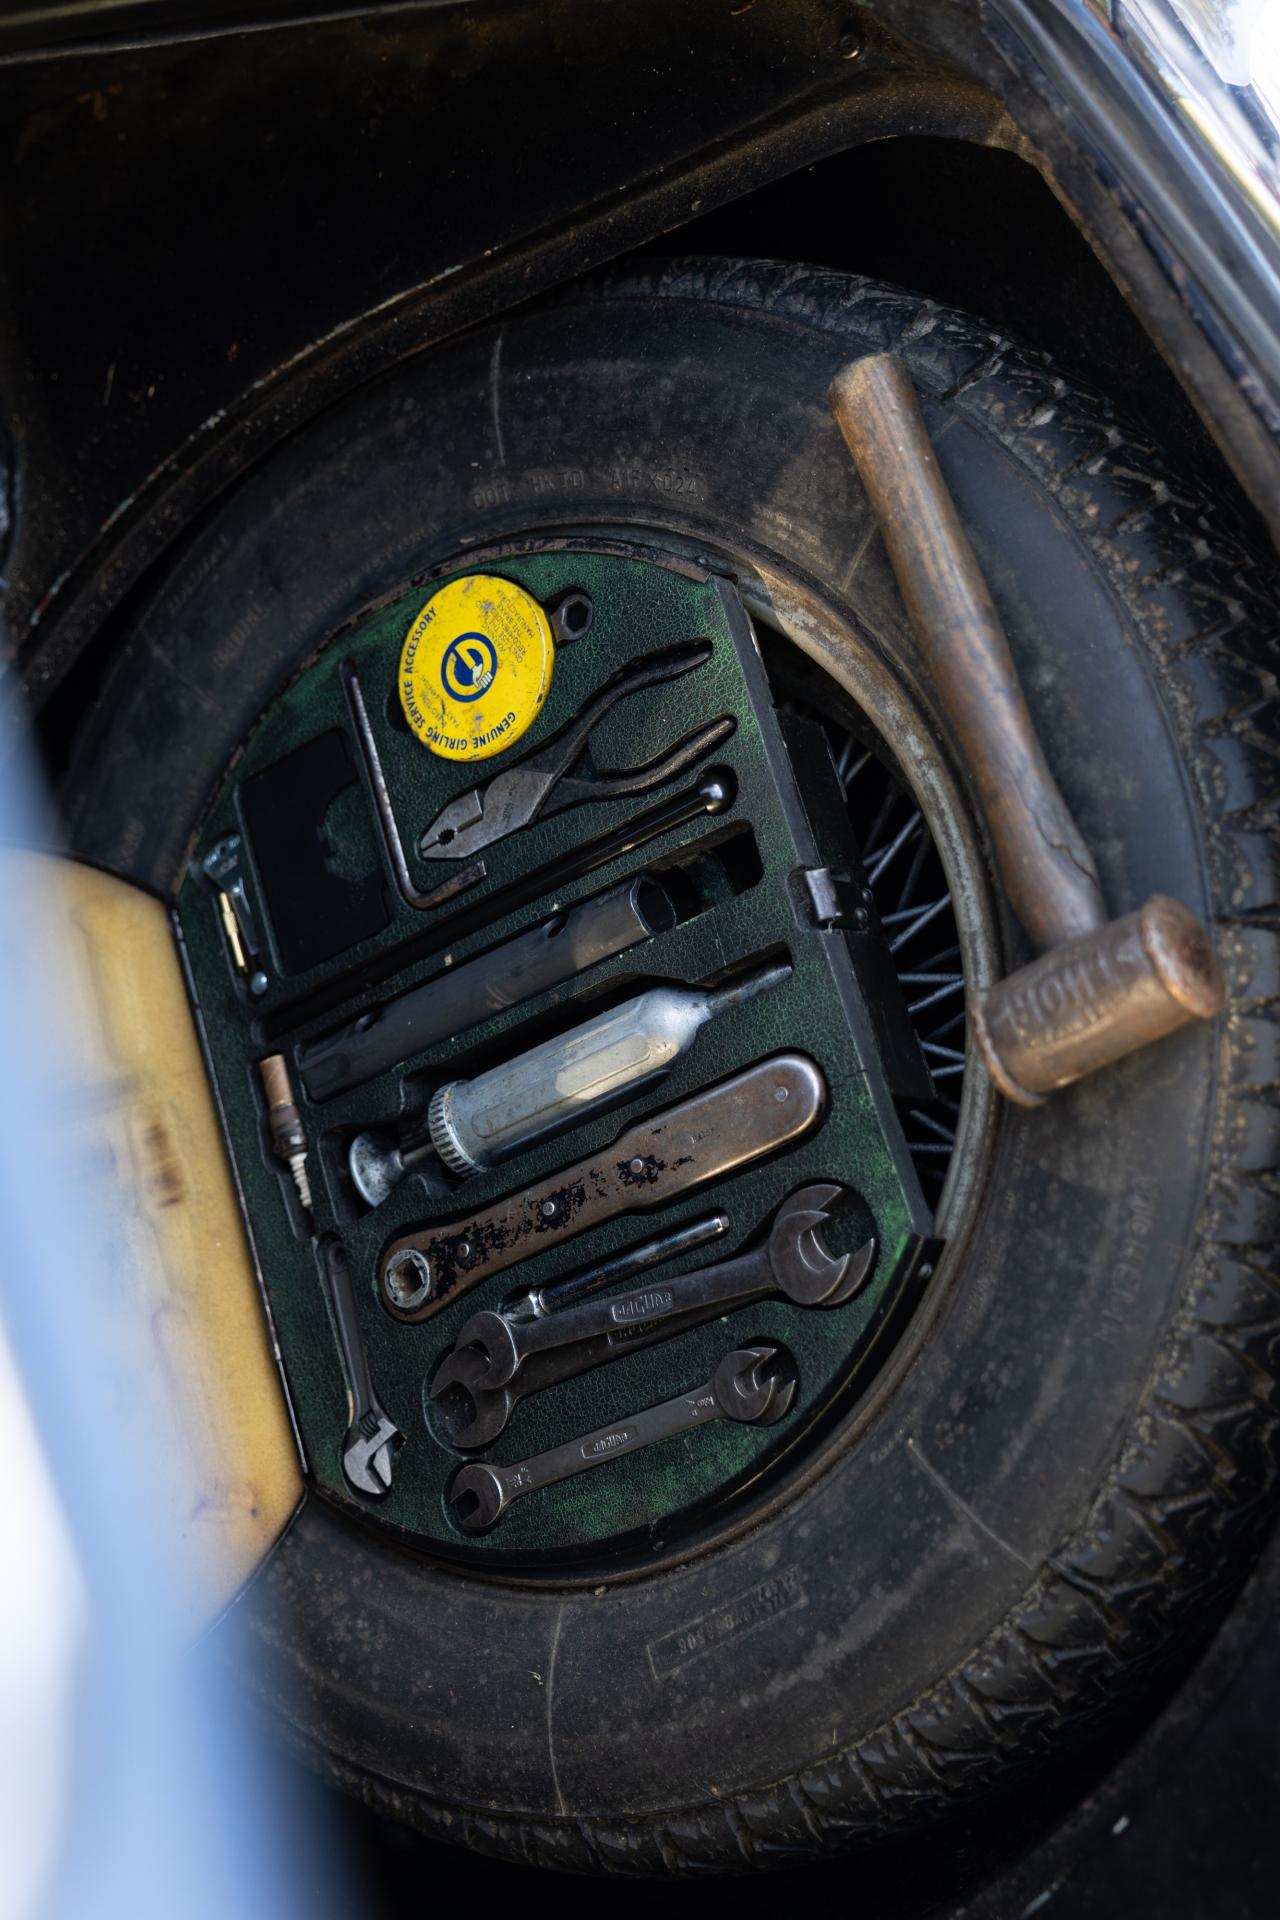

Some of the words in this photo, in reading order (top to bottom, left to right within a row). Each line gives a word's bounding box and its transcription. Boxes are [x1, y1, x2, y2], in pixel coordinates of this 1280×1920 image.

[404, 607, 437, 674] ACCESSORY
[404, 682, 426, 729] SERVICE
[425, 726, 467, 750] GIRLING
[473, 711, 516, 749] GENUINE
[617, 1291, 672, 1316] JAGUAR
[593, 1432, 627, 1452] JAGUAR
